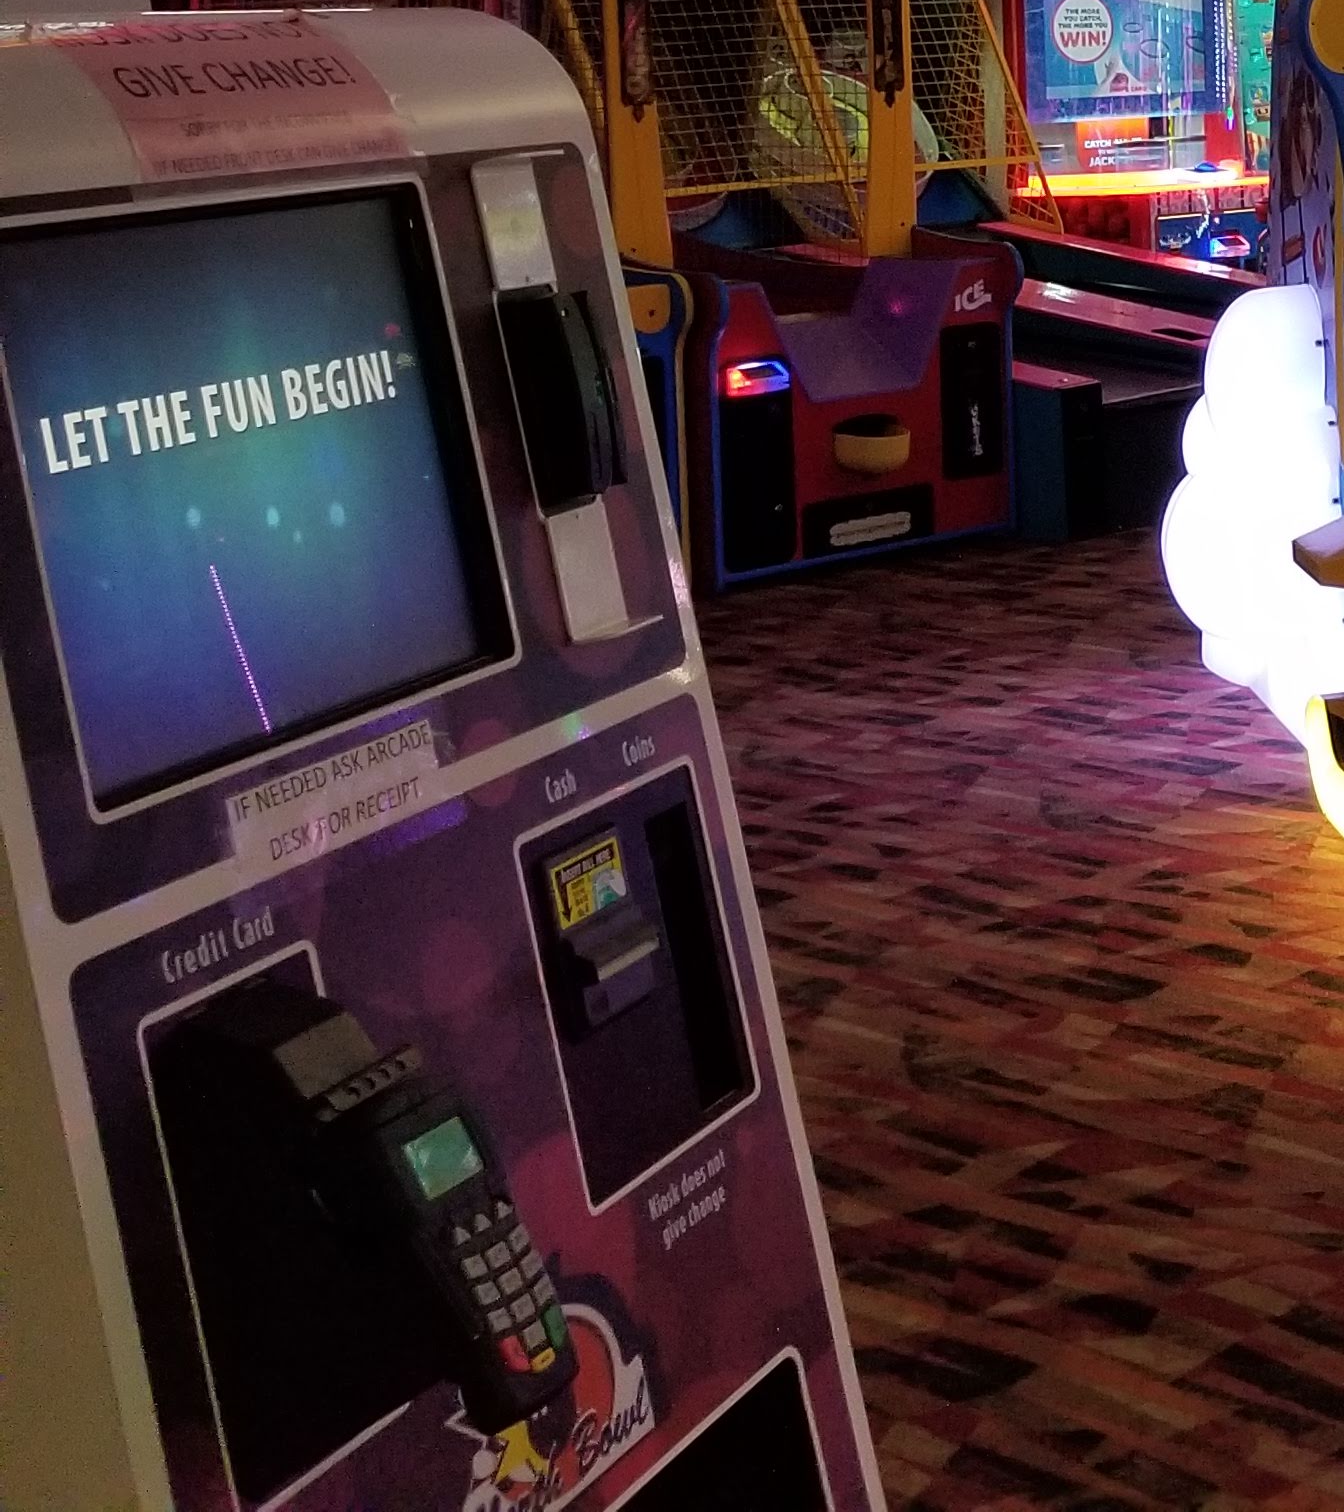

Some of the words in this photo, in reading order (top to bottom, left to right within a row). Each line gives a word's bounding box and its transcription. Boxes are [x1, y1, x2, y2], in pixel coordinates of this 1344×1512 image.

[1060, 30, 1107, 48] WIN!
[113, 64, 205, 98] GIVE
[202, 55, 357, 94] CHANGE!
[954, 279, 992, 312] ICE
[40, 406, 109, 474] LET
[117, 390, 196, 455] THE
[200, 374, 276, 438] FUN
[281, 350, 396, 420] BEGIN!
[233, 795, 250, 822] IF
[254, 765, 327, 813] NEEDED
[331, 749, 364, 782] ASK
[367, 723, 434, 767] ARCADE
[622, 735, 656, 767] Coins
[544, 768, 577, 803] Cash
[269, 821, 313, 861] DESK
[316, 806, 352, 841] FOR
[355, 776, 421, 824] RECEIPT
[162, 928, 229, 983] Credit
[232, 905, 275, 950] Card
[647, 1182, 680, 1221] Kiosk
[681, 1166, 706, 1198] does
[706, 1148, 726, 1179] not
[662, 1214, 687, 1250] give
[688, 1185, 726, 1227] change
